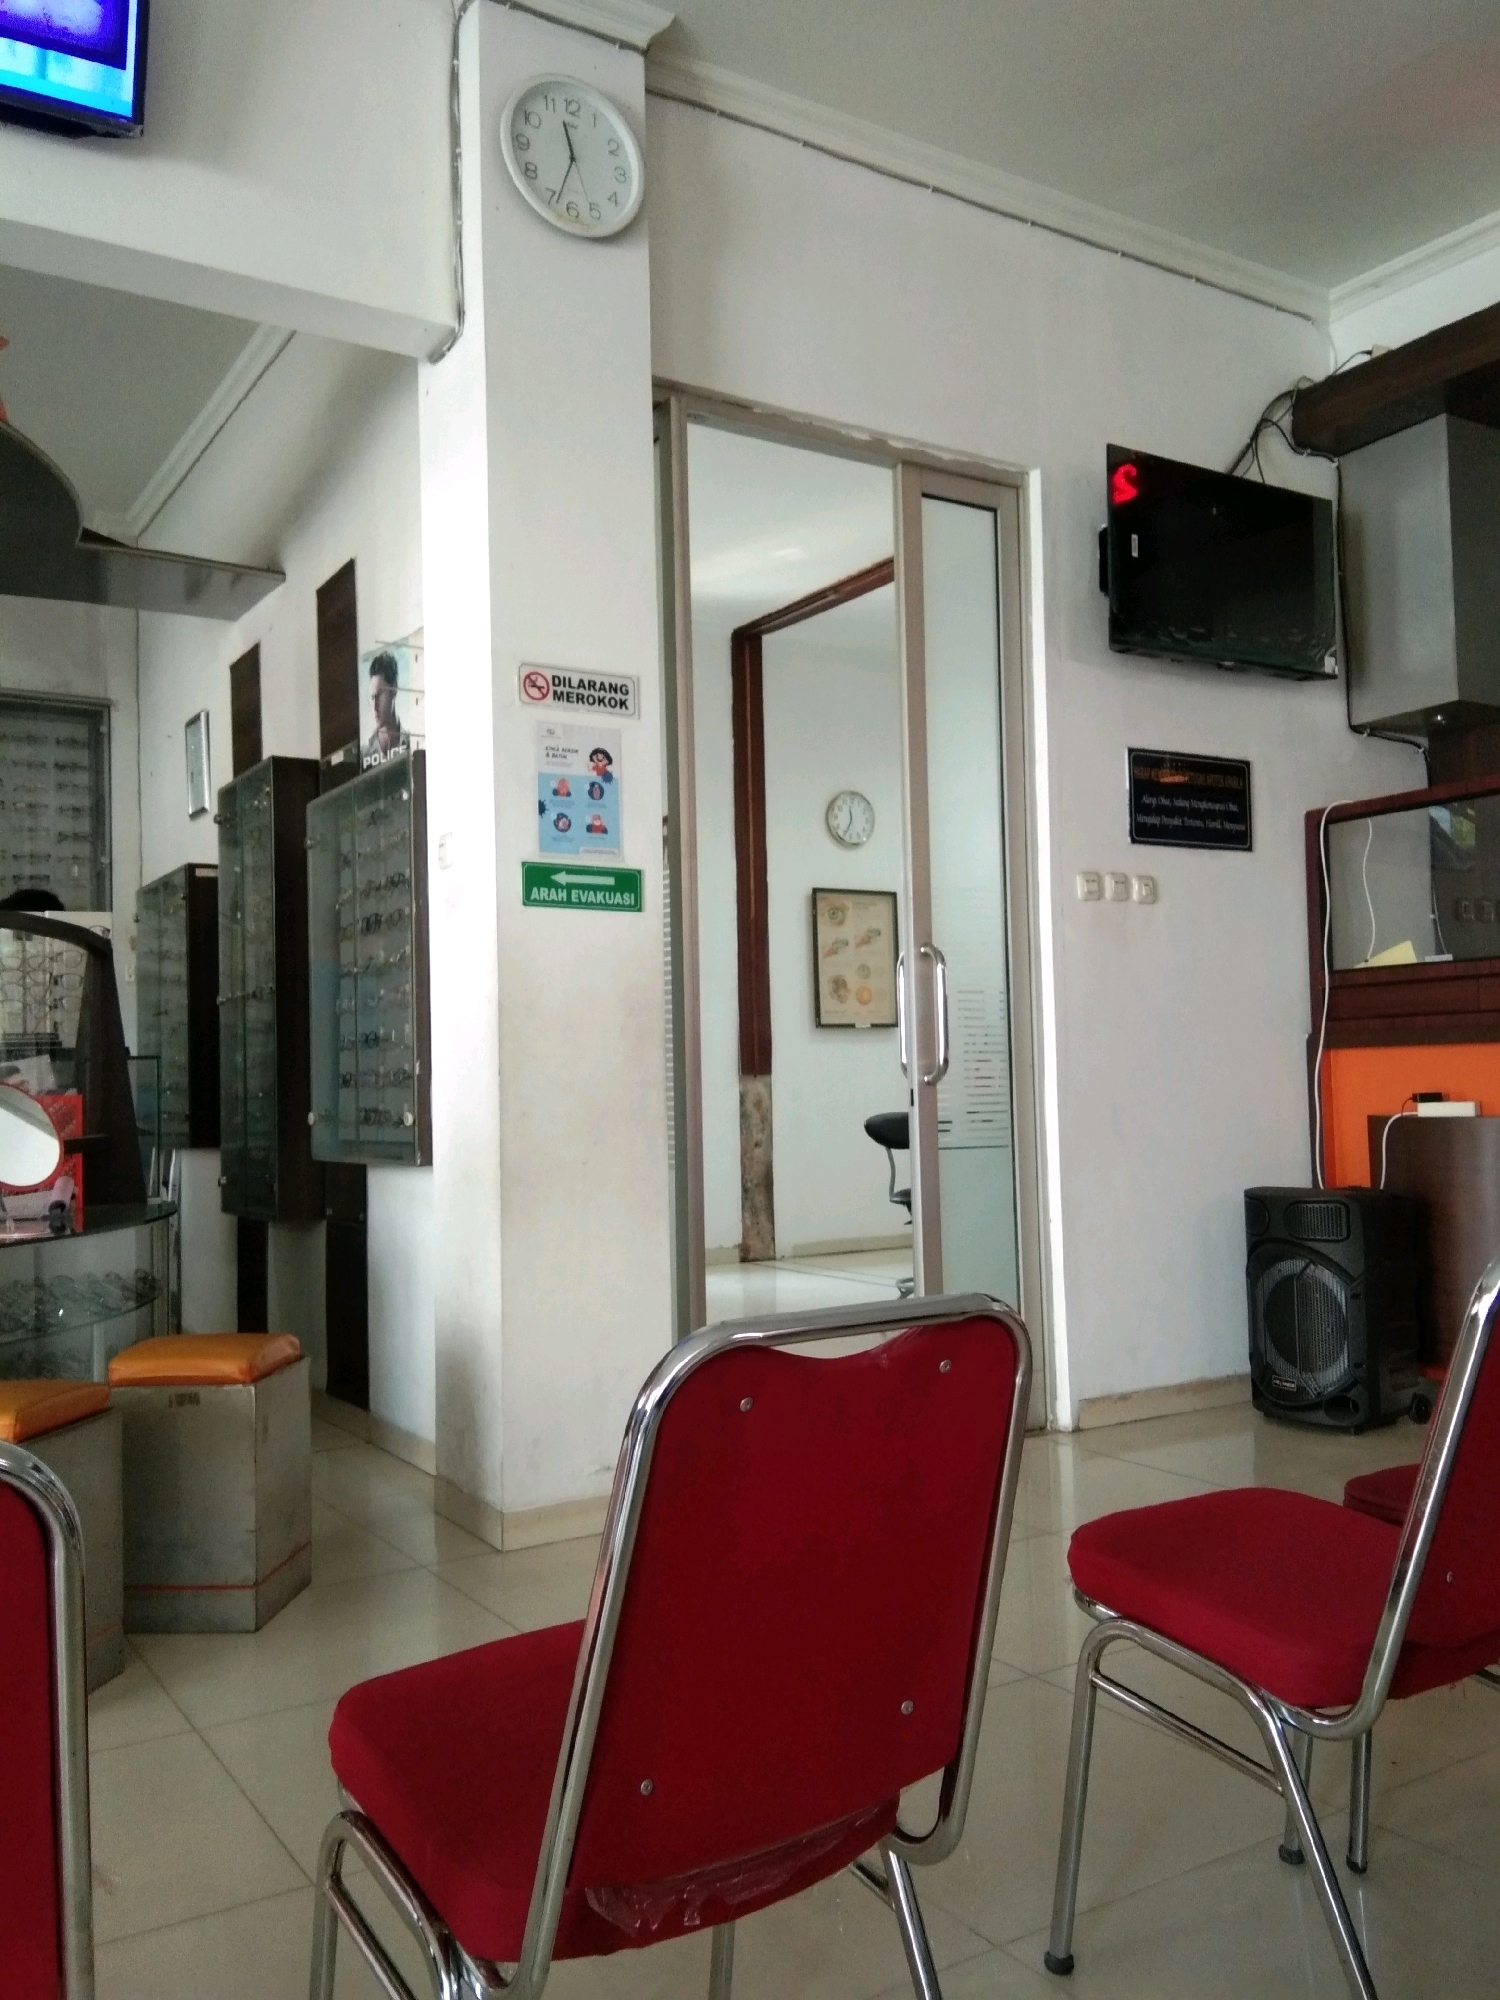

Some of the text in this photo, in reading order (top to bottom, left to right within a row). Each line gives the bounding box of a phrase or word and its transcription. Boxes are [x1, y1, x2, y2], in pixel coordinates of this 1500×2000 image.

[543, 95, 556, 113] 11
[564, 98, 581, 119] 12
[524, 110, 542, 130] 10
[516, 133, 530, 151] 9
[608, 139, 620, 157] 2
[525, 162, 538, 180] 8
[615, 167, 627, 184] 3
[545, 187, 556, 205] 7
[607, 191, 618, 208] 4
[566, 201, 579, 219] 6
[589, 202, 602, 220] 5
[551, 675, 629, 696] DILARANG
[552, 690, 629, 710] MEROKOK
[530, 887, 635, 906] ARAH EVAKUASI
